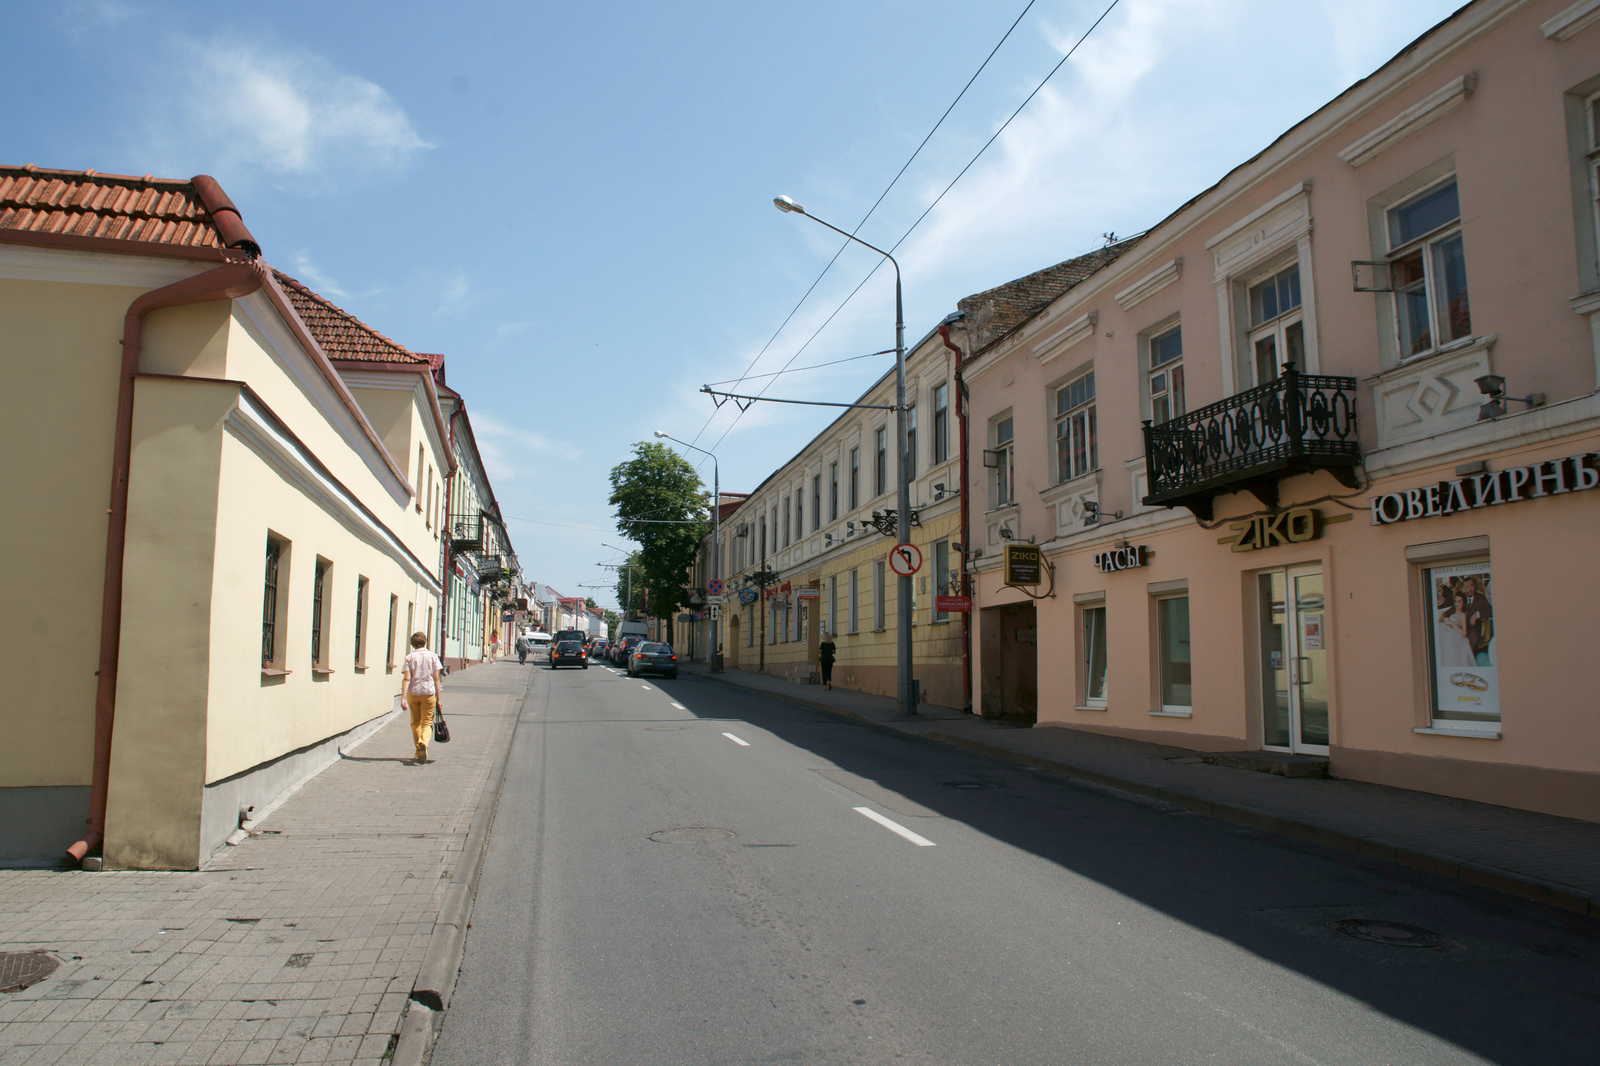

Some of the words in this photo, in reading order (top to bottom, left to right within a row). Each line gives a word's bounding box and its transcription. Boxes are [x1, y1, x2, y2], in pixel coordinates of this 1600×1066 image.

[1230, 509, 1315, 553] ZIKO
[1011, 551, 1038, 561] ZIKO
[1093, 546, 1142, 573] ЧАСЫ
